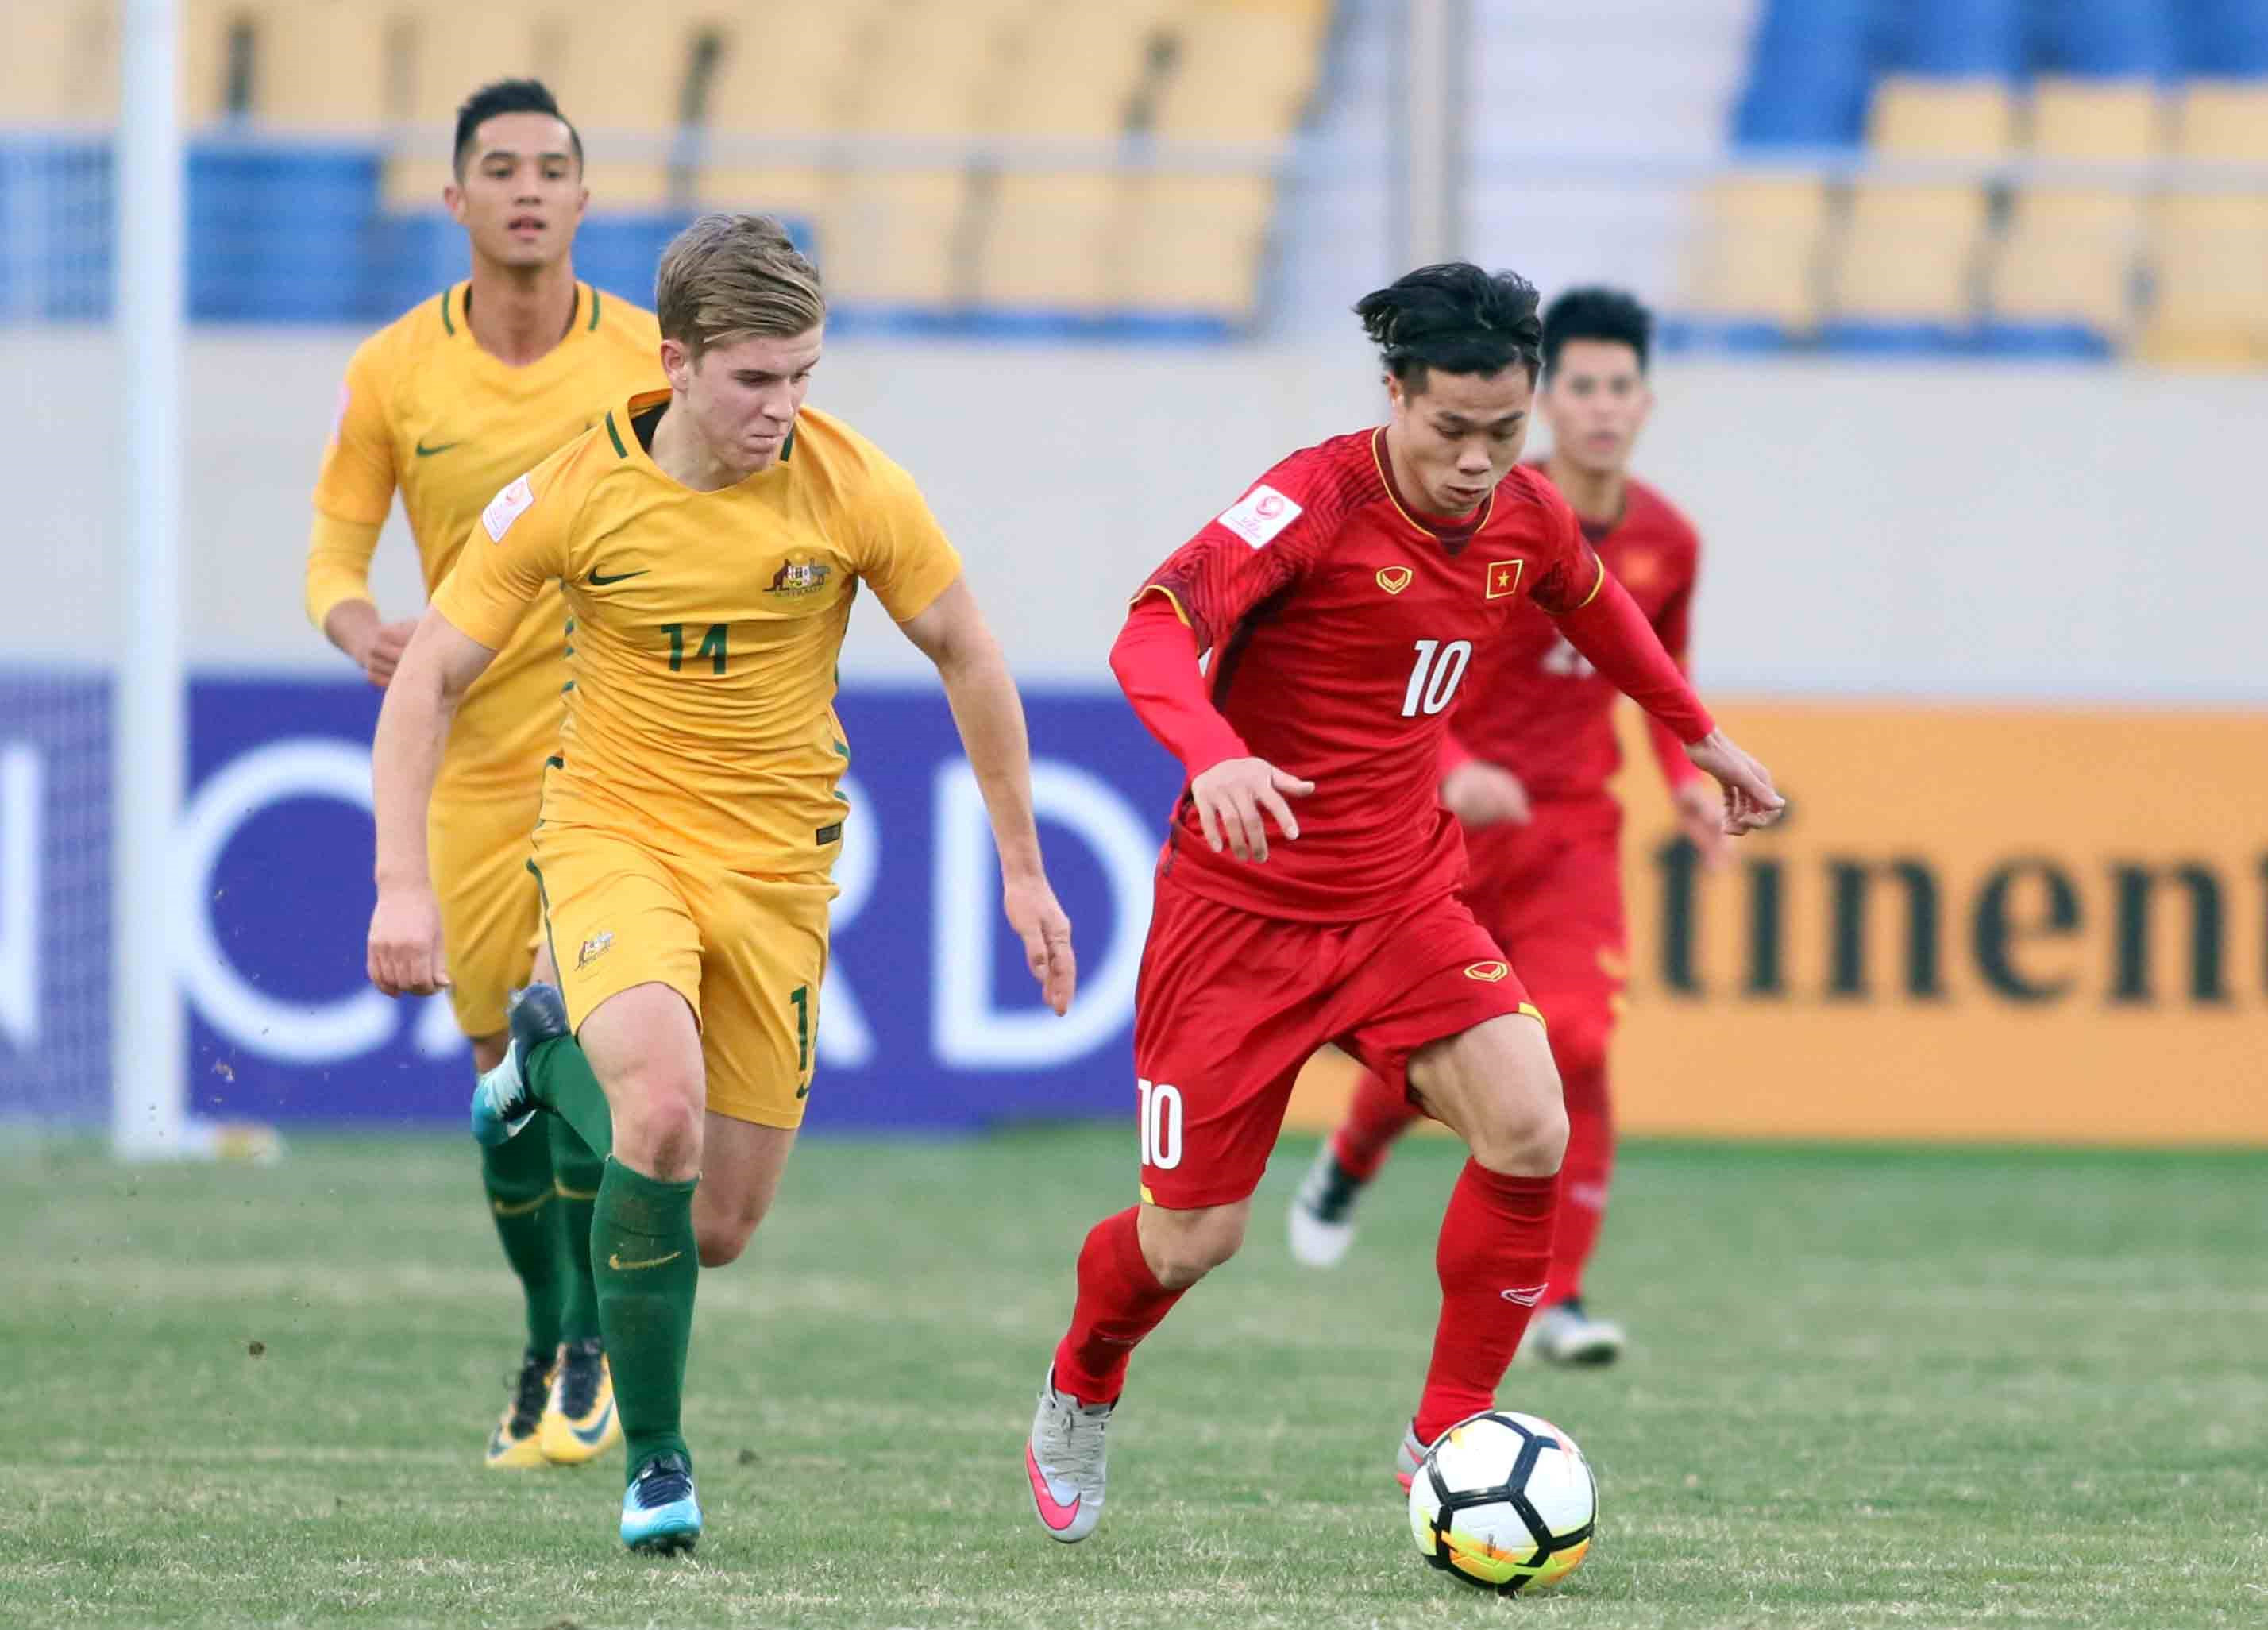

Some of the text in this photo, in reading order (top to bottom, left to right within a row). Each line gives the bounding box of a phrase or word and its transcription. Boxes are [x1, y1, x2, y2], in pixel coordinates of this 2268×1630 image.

[660, 623, 728, 675] 14
[1401, 639, 1473, 717] 10
[165, 739, 1163, 1068] CD
[1653, 791, 2268, 1006] tinen
[1137, 1077, 1182, 1169] 10
